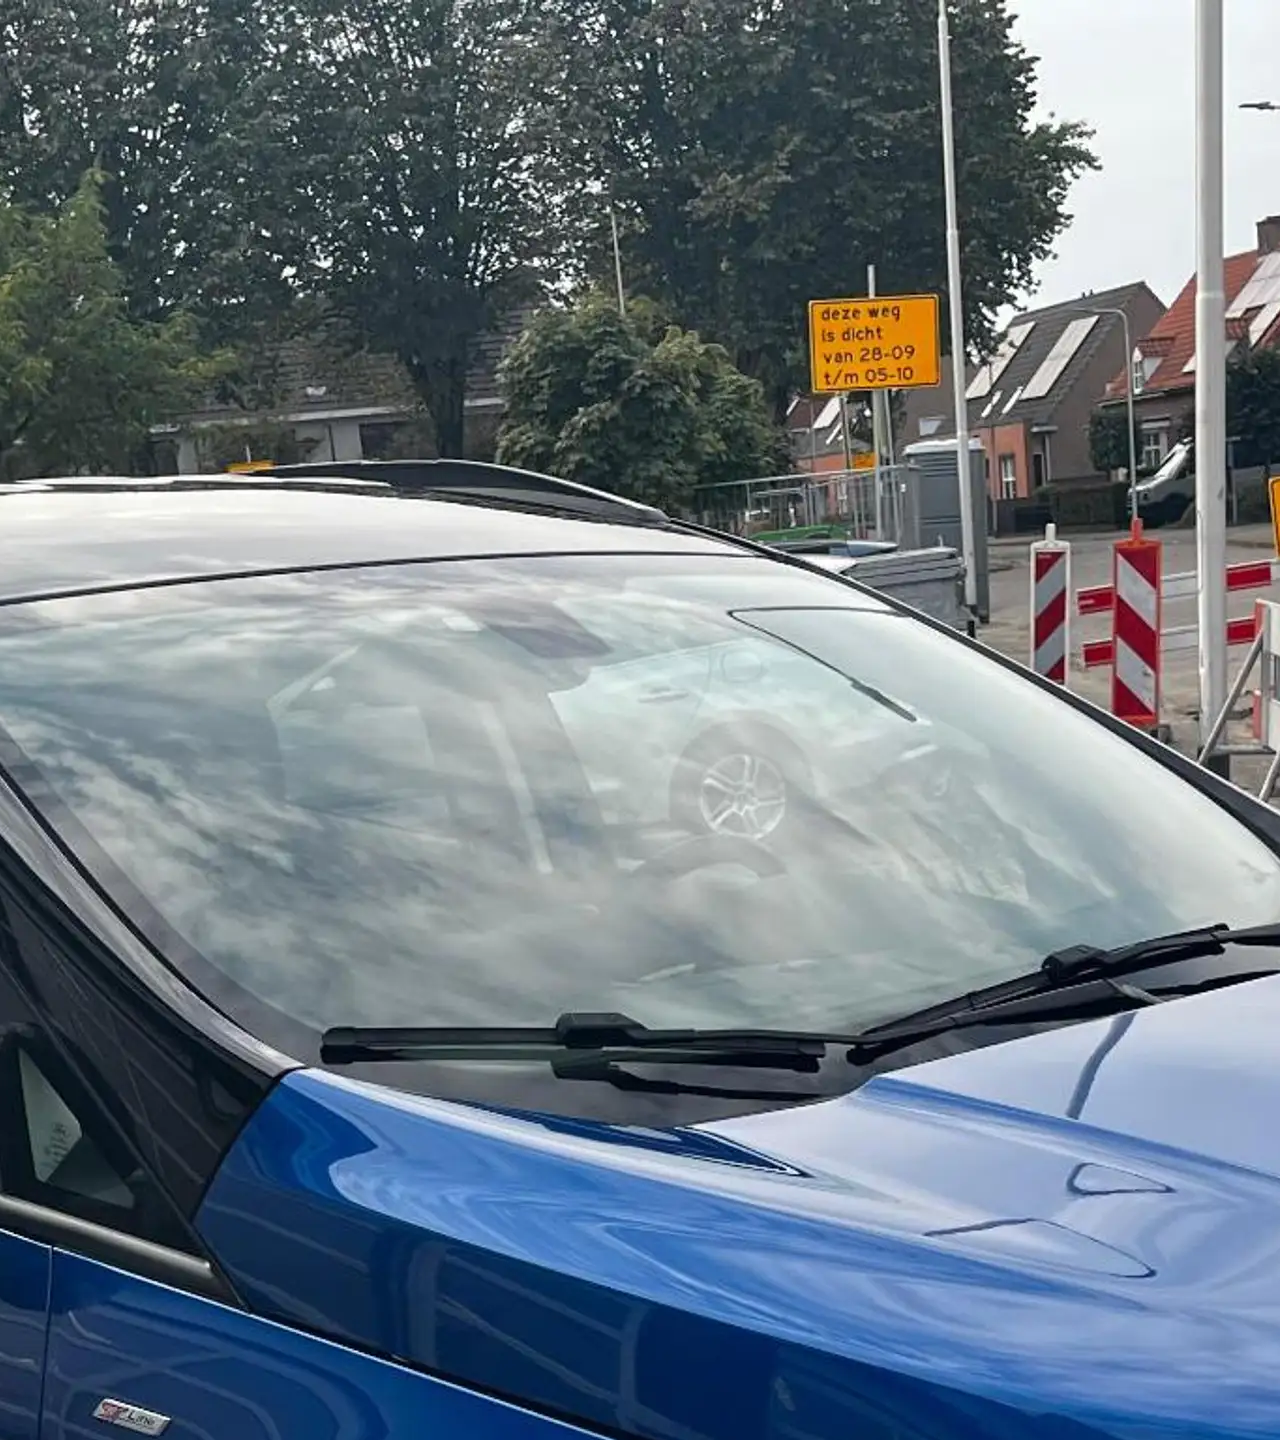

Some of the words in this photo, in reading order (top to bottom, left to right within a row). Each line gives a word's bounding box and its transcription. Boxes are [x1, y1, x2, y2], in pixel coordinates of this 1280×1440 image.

[822, 307, 861, 321] deze
[867, 305, 901, 321] weg
[821, 329, 835, 342] is
[841, 327, 882, 342] dicht
[824, 352, 853, 364] van
[860, 345, 915, 361] 28-09
[824, 370, 859, 386] t/m
[865, 366, 914, 383] 05-10
